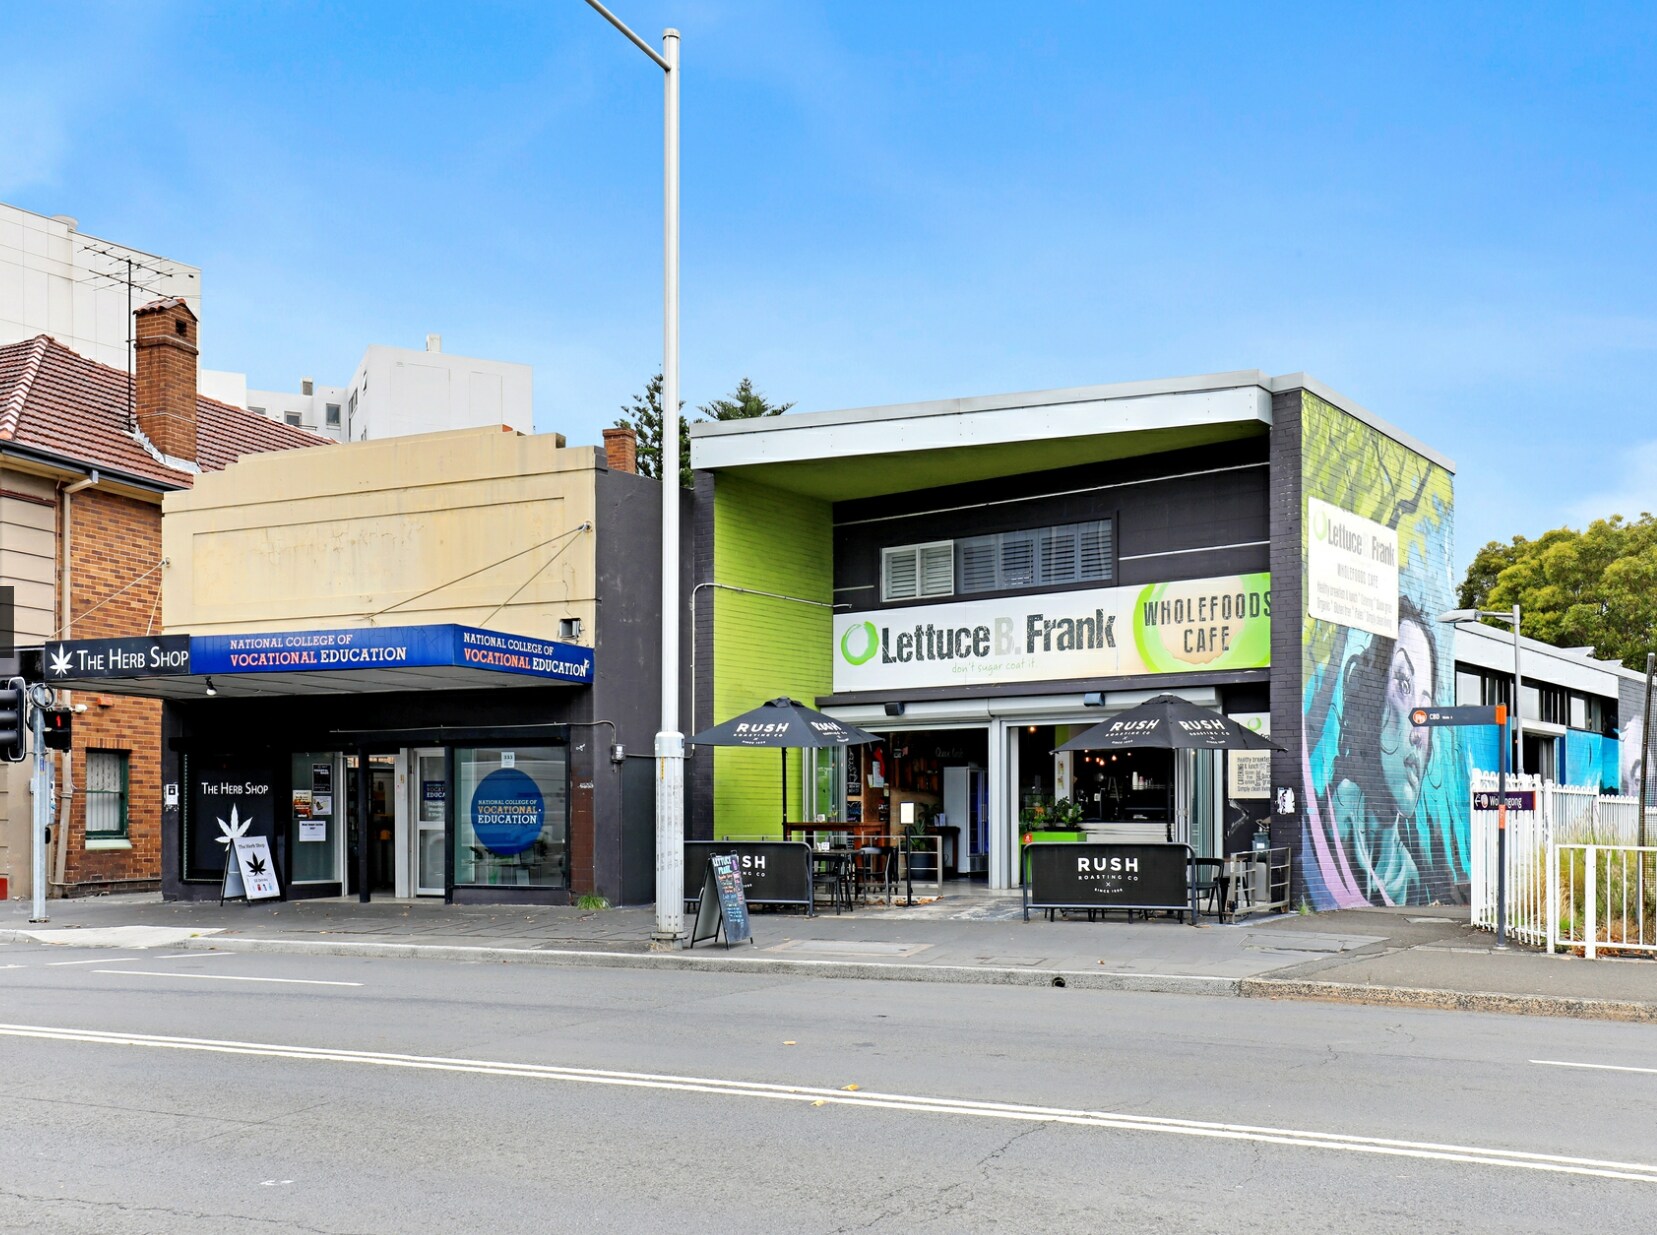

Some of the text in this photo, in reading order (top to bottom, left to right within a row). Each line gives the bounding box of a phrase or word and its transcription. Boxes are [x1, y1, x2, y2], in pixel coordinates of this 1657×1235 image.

[1143, 590, 1271, 626] WHOLEFOODS
[230, 634, 353, 649] NATIONAL COLLEGE OF
[464, 632, 554, 656] NATIONAL COLLEGE OF
[881, 609, 1116, 664] Lettuce B. Frank
[1183, 626, 1230, 653] CAFE
[230, 647, 407, 667] VOCATIONAL EDUCATION
[464, 648, 586, 677] VOCATIONAL EDUCATION
[978, 662, 1002, 676] sugar
[1006, 661, 1024, 670] coat
[736, 722, 790, 733] RUSH
[1109, 718, 1160, 732] RUSH
[1178, 719, 1226, 731] RUSH
[478, 806, 538, 814] VOCATIONAL
[478, 814, 537, 824] EDUCATION
[742, 855, 765, 869] SH
[1077, 857, 1138, 872] RUSH
